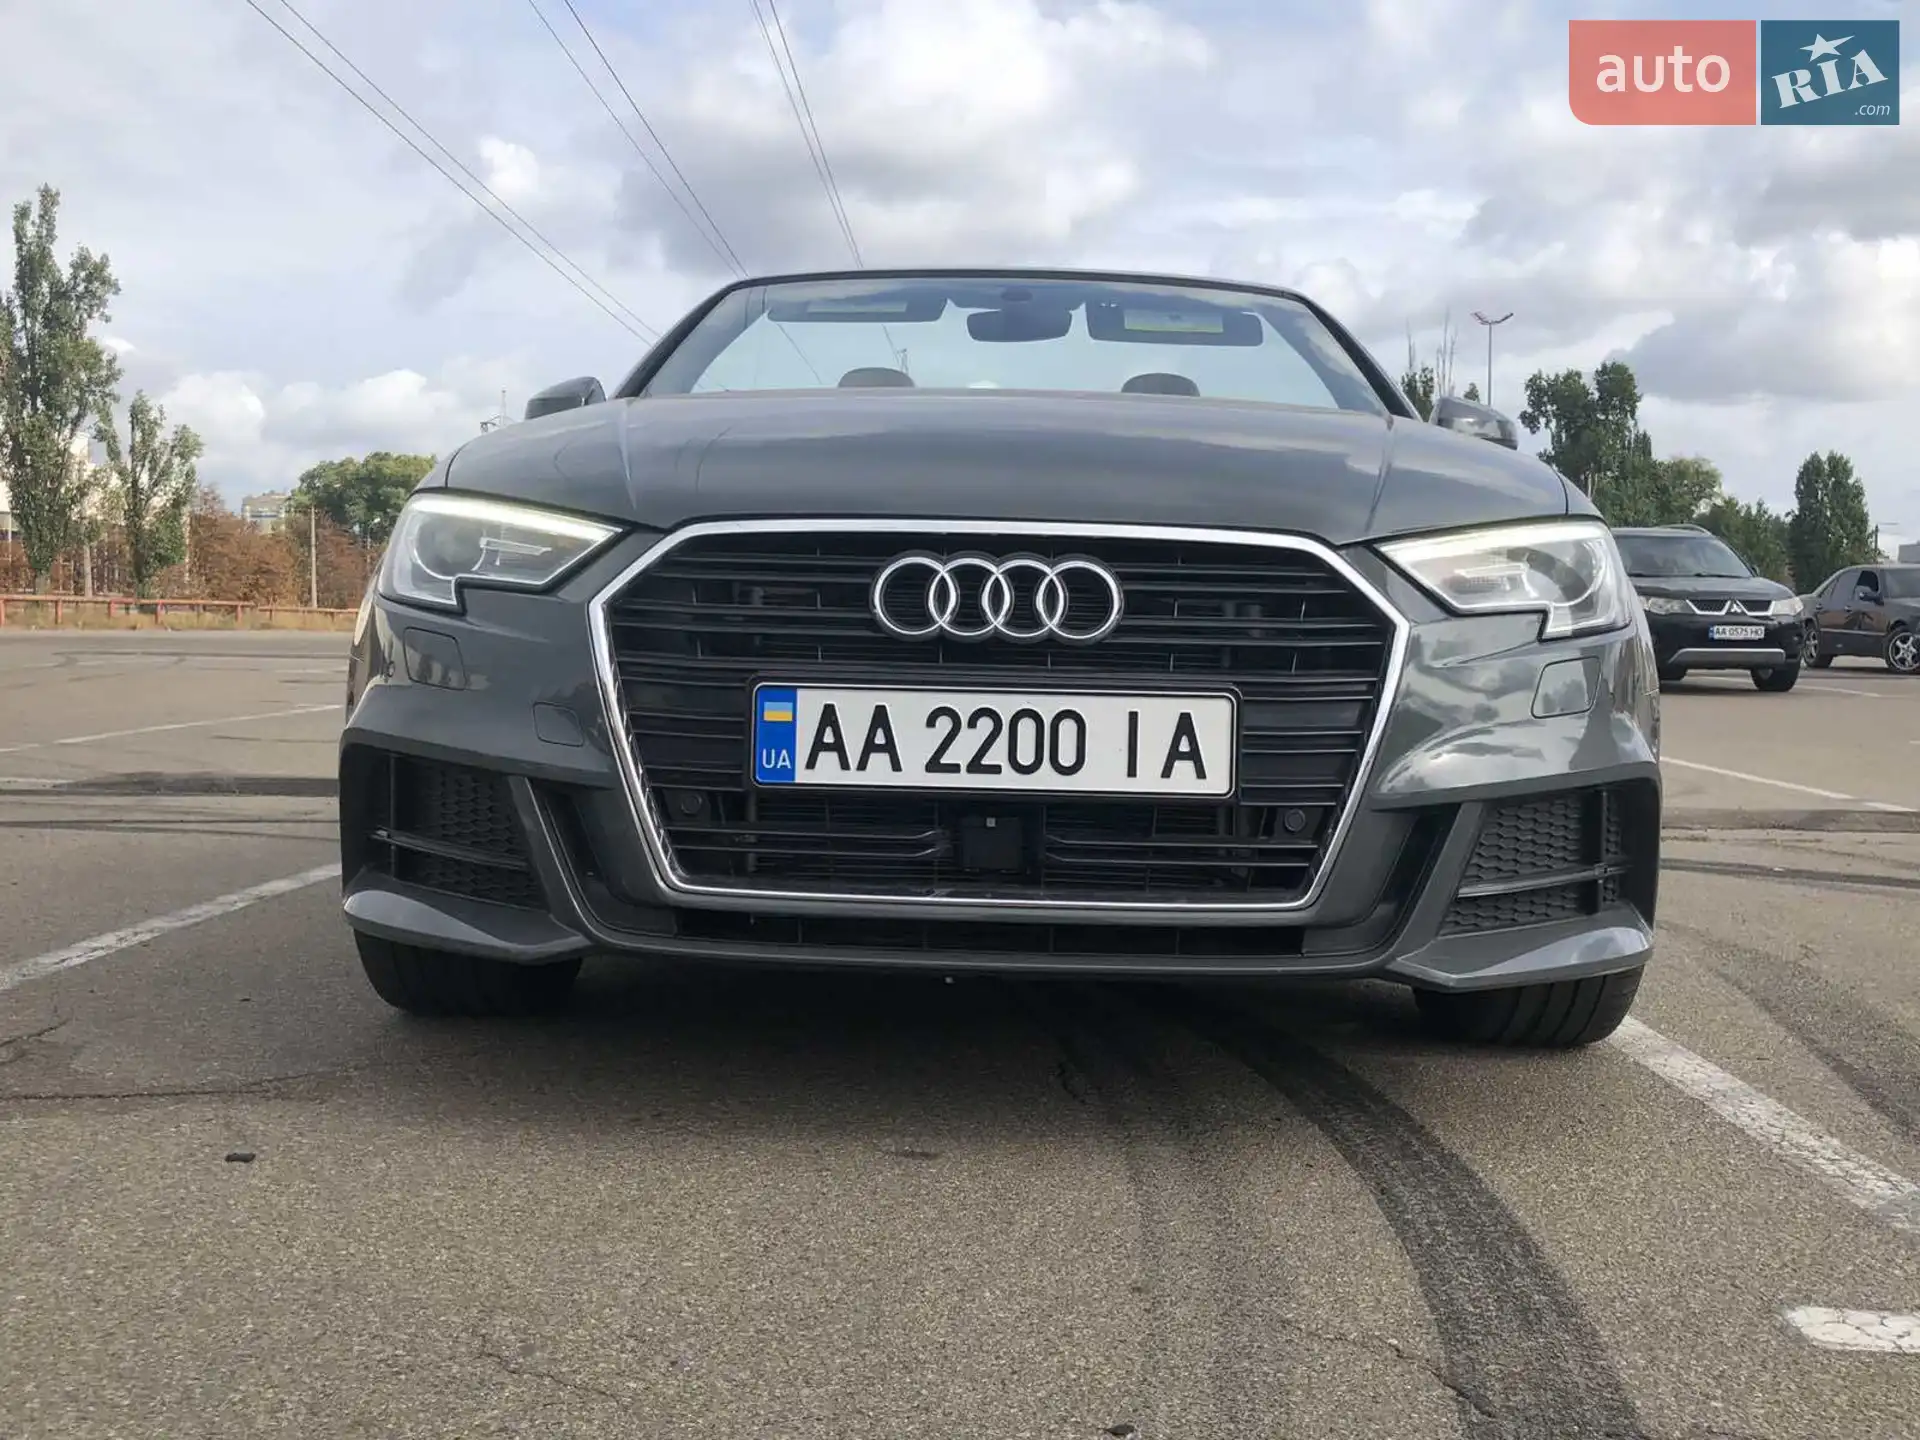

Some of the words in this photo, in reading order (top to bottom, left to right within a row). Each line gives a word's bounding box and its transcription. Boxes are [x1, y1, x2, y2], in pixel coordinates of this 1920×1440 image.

[1715, 627, 1727, 635] AA
[804, 703, 903, 772] AA
[924, 705, 1088, 776] 2200
[1127, 710, 1207, 779] IA
[762, 748, 792, 770] UA
